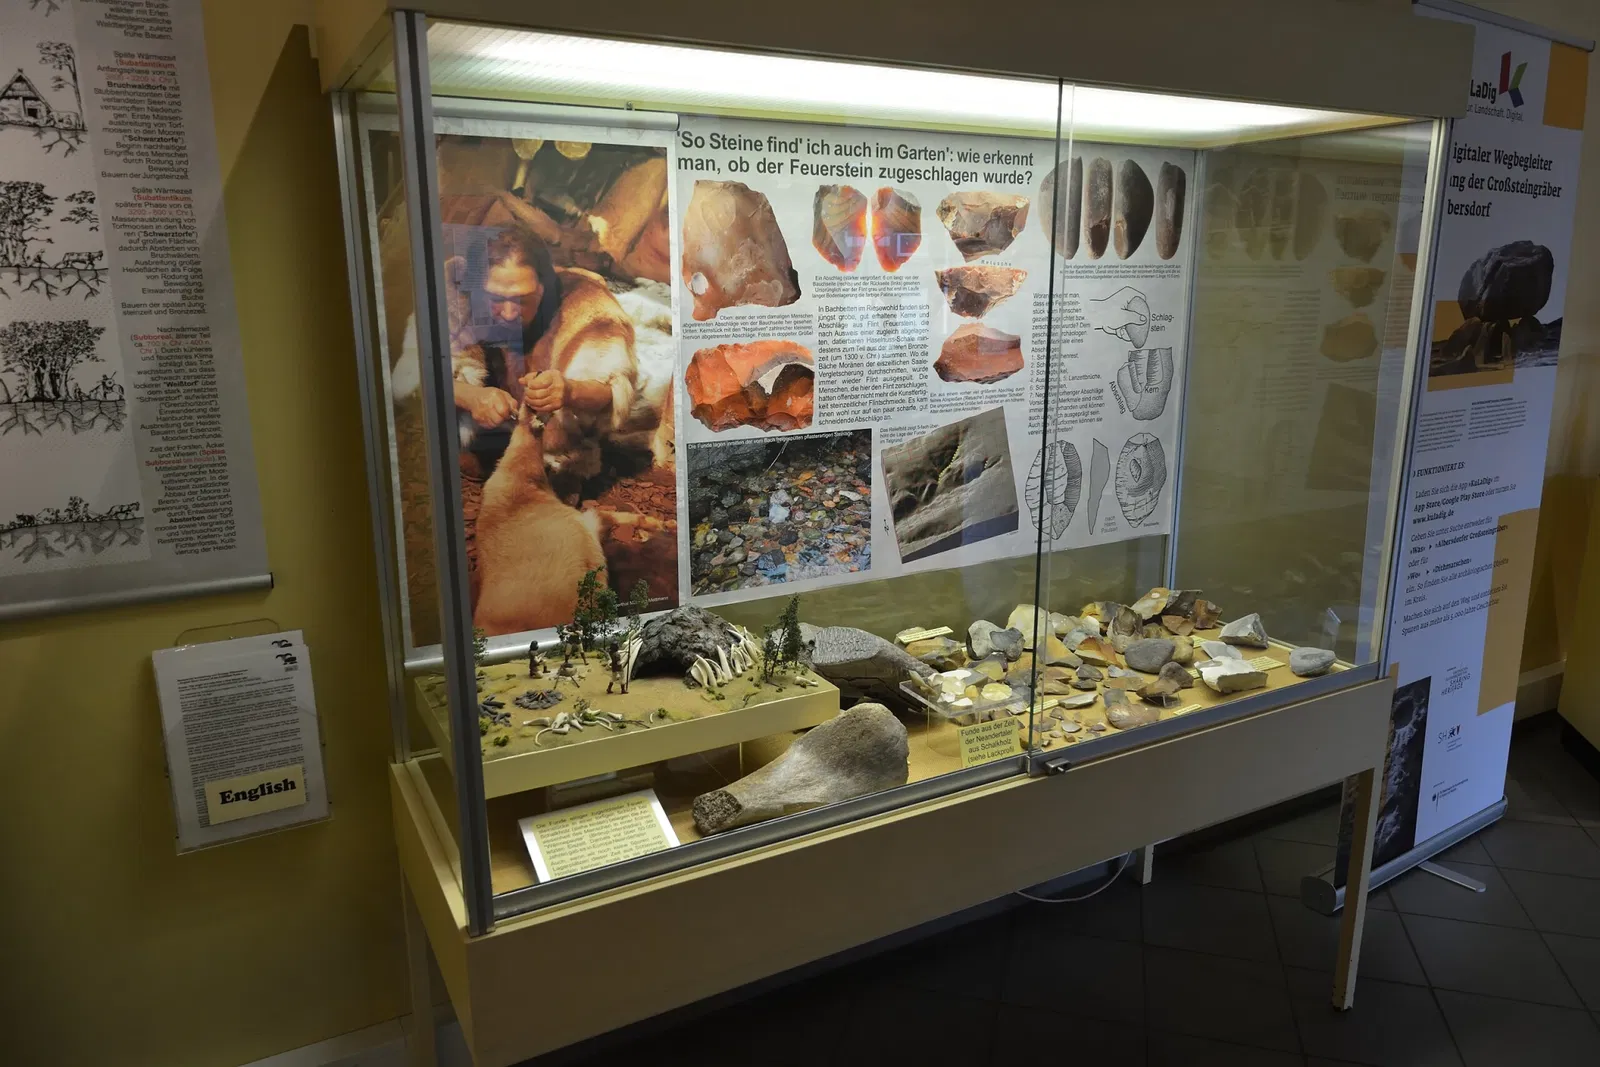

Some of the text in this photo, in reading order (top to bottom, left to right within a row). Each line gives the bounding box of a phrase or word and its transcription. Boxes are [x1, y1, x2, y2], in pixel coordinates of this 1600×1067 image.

[1470, 79, 1496, 104] LaDig
[710, 132, 763, 152] Steine
[806, 138, 830, 156] ich
[834, 140, 872, 159] auch
[876, 142, 893, 159] im
[957, 147, 980, 163] wie
[983, 149, 1033, 167] erkennt
[1453, 142, 1553, 172] igitaler Wegbegleiter
[678, 156, 1033, 186] man, ob der Feuerstein zugeschlagen wurde?
[1467, 173, 1485, 190] der
[1487, 176, 1562, 199] Großsteingräber
[1447, 199, 1492, 217] bersdorf
[818, 314, 835, 322] jüngst
[1151, 314, 1174, 323] Schlag-
[1150, 324, 1166, 332] stein
[831, 354, 842, 363] (um
[819, 369, 863, 379] Vergletscherung
[842, 376, 861, 384] wieder
[1144, 385, 1159, 393] Kern
[1109, 380, 1126, 415] Abschlag
[883, 407, 895, 415] paar
[819, 416, 854, 425] schneidende
[855, 414, 883, 425] Abschläge
[1417, 463, 1456, 478] FUNKTIONIERT
[1415, 489, 1430, 499] Laden
[1431, 487, 1439, 495] Sie
[1439, 485, 1449, 494] sich
[1459, 483, 1468, 491] App
[1414, 504, 1425, 513] App
[1460, 493, 1470, 502] Play
[1471, 491, 1485, 499] Store
[1412, 509, 1454, 524] www.kuladig.de
[1411, 532, 1427, 542] Geben
[1427, 529, 1435, 538] Sie
[1408, 558, 1419, 568] oder
[1402, 613, 1423, 623] Machen
[961, 727, 980, 736] Funde
[1004, 719, 1015, 727] Zeit
[976, 729, 1012, 743] Neandertaler
[981, 738, 1011, 750] Schalkholz
[968, 754, 986, 764] (siehe
[219, 778, 296, 805] English
